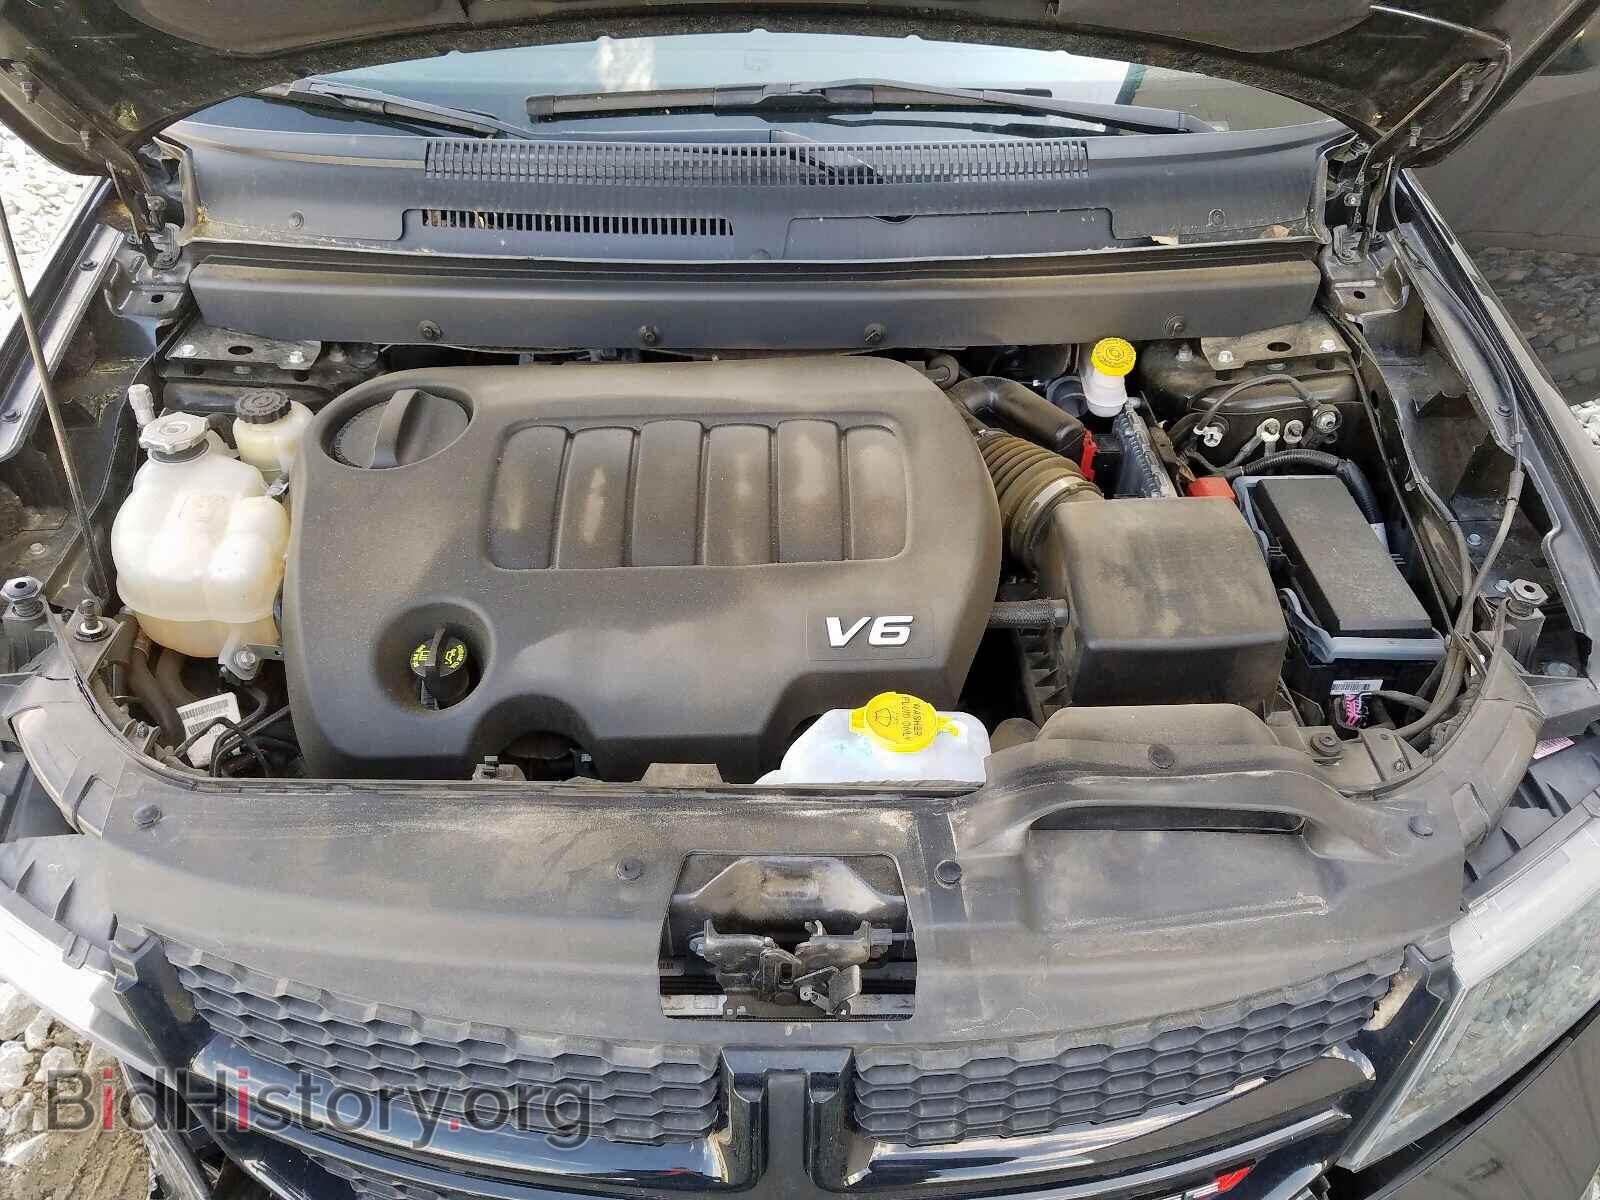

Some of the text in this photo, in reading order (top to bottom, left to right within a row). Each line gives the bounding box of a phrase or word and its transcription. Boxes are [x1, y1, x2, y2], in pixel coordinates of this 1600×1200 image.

[825, 616, 914, 648] V6
[902, 696, 912, 741] FLUID ONLY
[912, 703, 923, 737] WASHER
